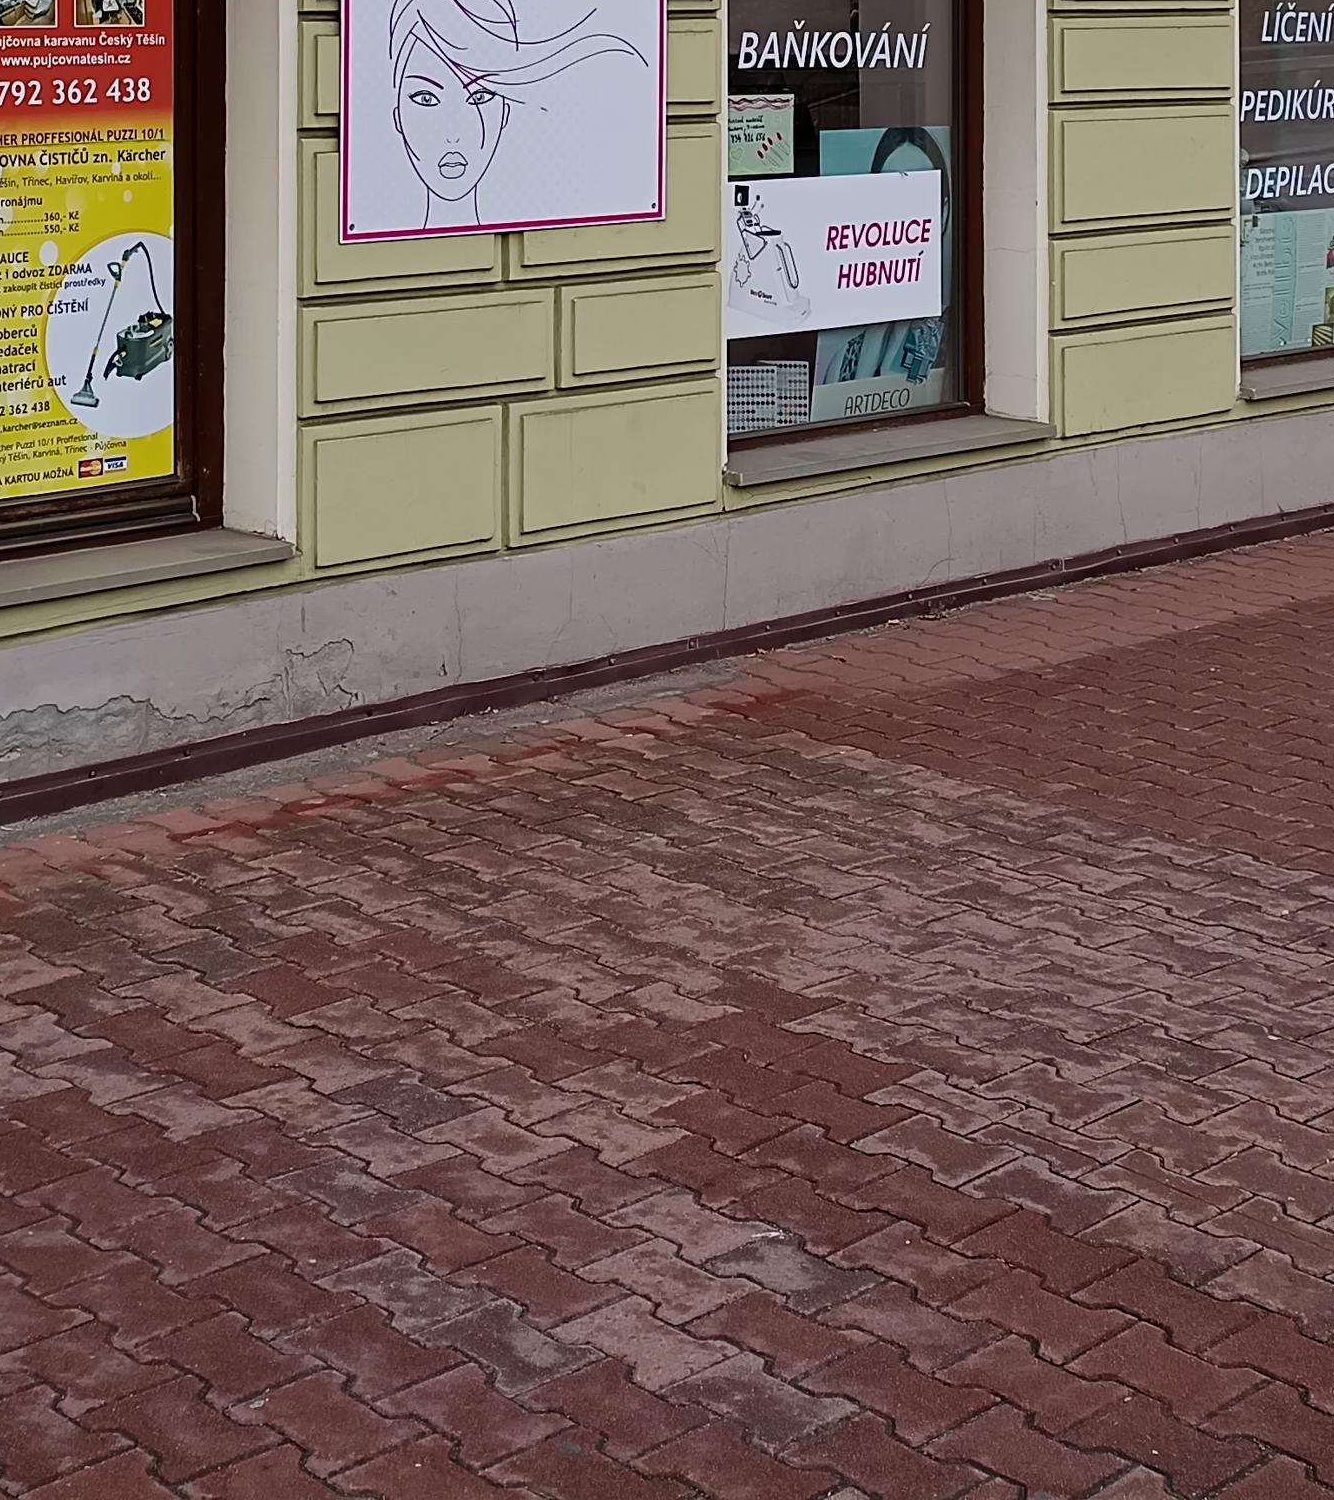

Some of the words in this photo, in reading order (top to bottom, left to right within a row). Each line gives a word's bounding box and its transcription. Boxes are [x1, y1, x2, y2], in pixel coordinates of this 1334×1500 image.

[1261, 2, 1334, 43] LÍČENÍ
[43, 34, 95, 47] karavanu
[99, 31, 133, 46] Český
[136, 32, 165, 46] Těšín
[738, 20, 930, 69] BAŇKOVÁNÍ
[1, 53, 131, 68] www.pujcovnatesin.cz
[52, 79, 97, 104] 362
[106, 78, 151, 102] 438
[21, 128, 103, 144] PROFFESIONÁL
[107, 129, 137, 140] PUZZI
[141, 128, 164, 140] 10/1
[40, 148, 88, 165] ČISTIČŮ
[93, 153, 112, 163] zn.
[117, 150, 165, 162] Kärcher
[826, 219, 931, 250] REVOLUCE
[12, 267, 44, 279] odvoz
[48, 263, 92, 276] ZDARMA
[838, 251, 924, 289] HUBNUTÍ
[3, 283, 37, 294] zakoupit
[21, 304, 43, 317] PRO
[47, 298, 88, 315] ČIŠTĚNÍ
[48, 375, 67, 387] aut
[9, 404, 27, 415] 362
[32, 402, 50, 412] 438
[843, 388, 910, 416] ARTDECO
[5, 472, 40, 485] KARTOU
[43, 468, 74, 480] MOŽNÁ
[107, 461, 124, 469] VISA
